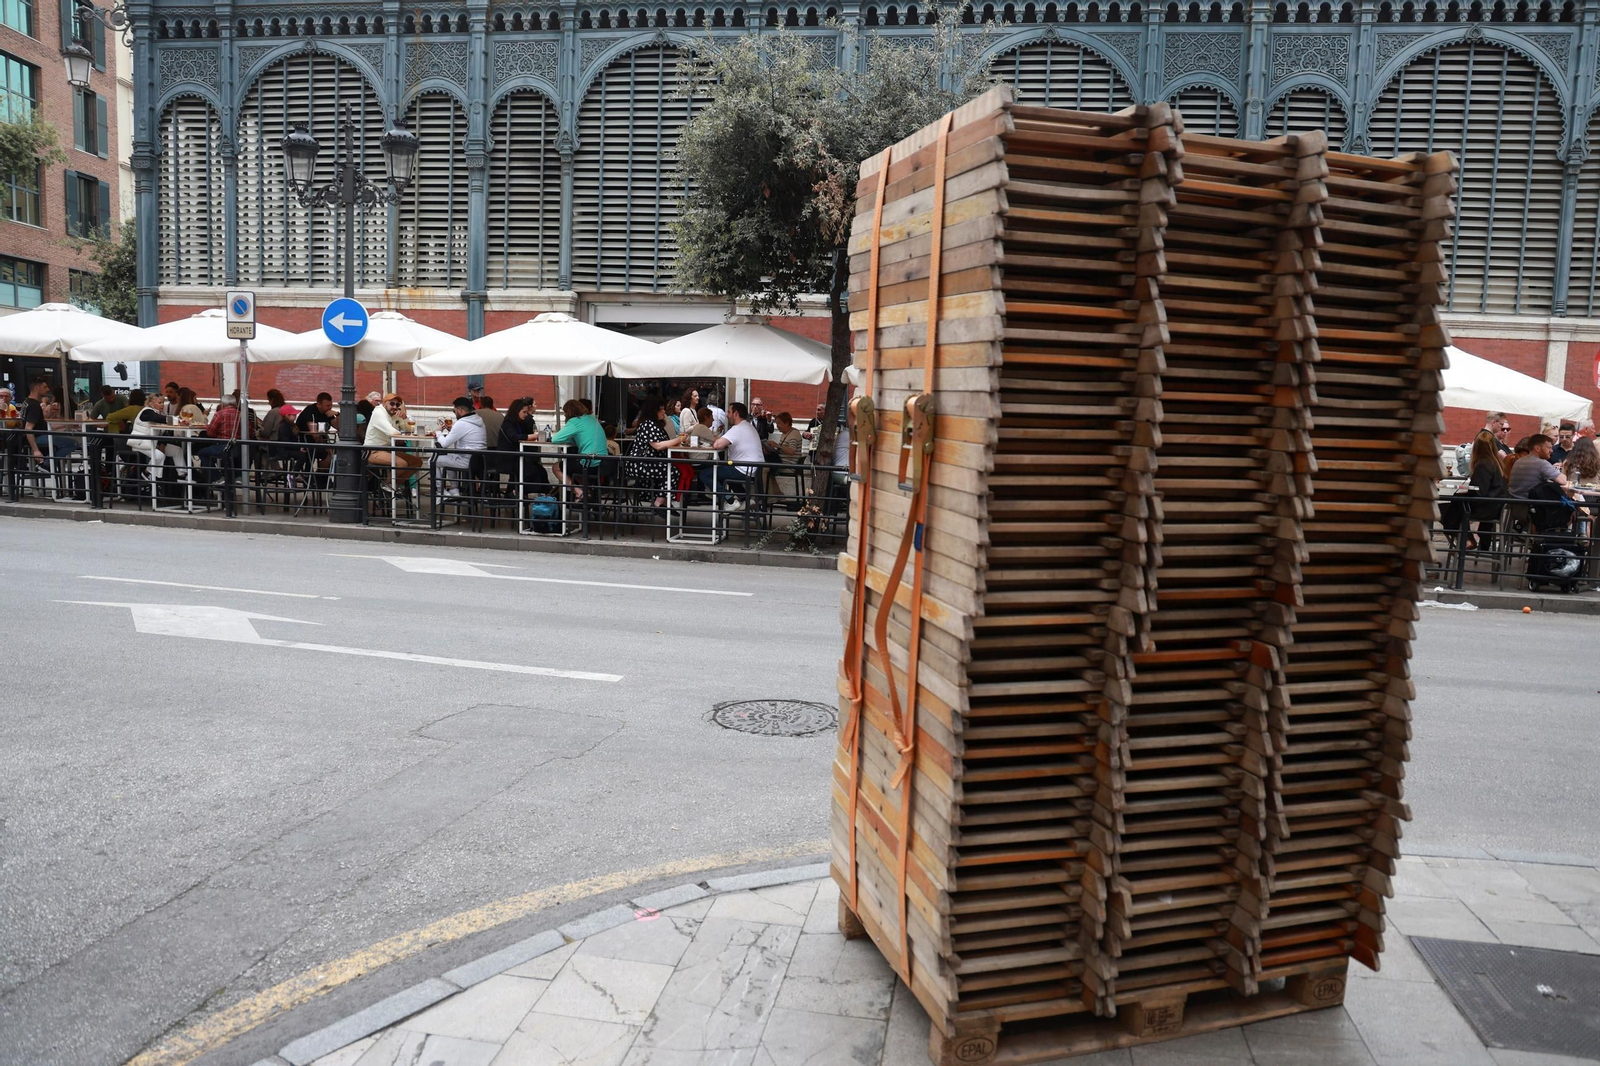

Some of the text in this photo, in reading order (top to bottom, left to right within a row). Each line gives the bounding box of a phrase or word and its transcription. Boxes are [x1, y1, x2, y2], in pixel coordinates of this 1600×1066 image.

[230, 327, 252, 335] HIDRANTE
[1318, 982, 1339, 998] EPAL
[961, 1042, 988, 1058] EPAL
